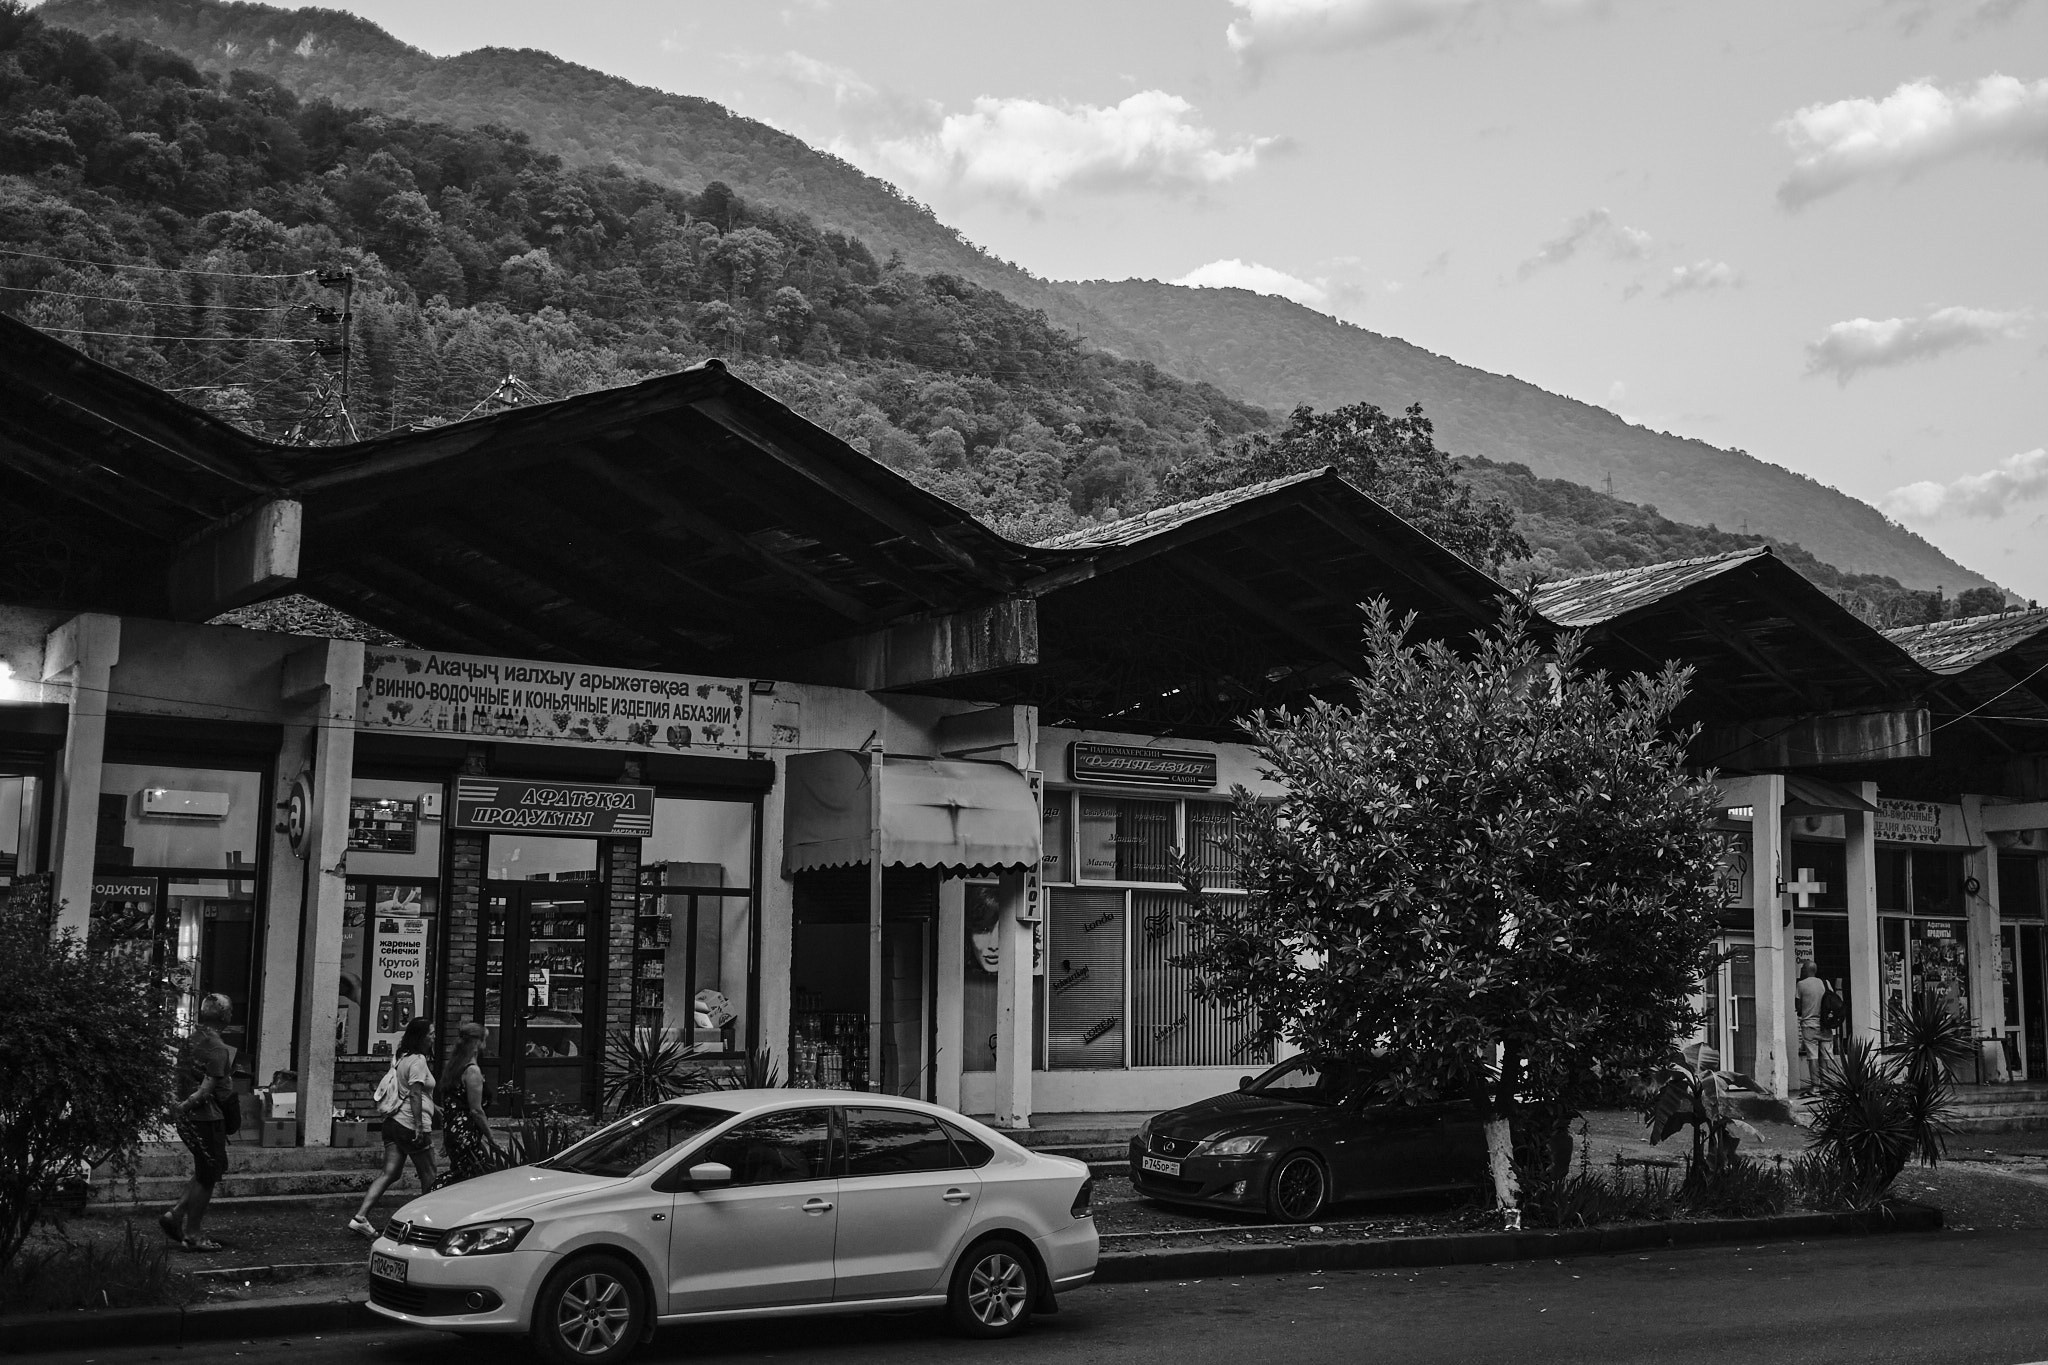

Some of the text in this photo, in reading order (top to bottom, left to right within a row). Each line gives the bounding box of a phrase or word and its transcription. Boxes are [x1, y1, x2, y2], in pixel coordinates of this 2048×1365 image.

[504, 666, 575, 690] иалхыу
[376, 678, 730, 724] ВИННО-ВОДОЧНЫЕ И КОНЬЯЧНЫЕ ИЗДЕЛИЯ АБХАЗИИ
[1171, 775, 1196, 784] САЛОН
[471, 807, 595, 827] ПРОДУКТЫ
[1874, 809, 1933, 822] НО-ВОДОЧНЫЕ
[1874, 821, 1900, 832] ДЕЛИЯ
[91, 884, 151, 896] ОДУКТЫ
[1083, 912, 1114, 933] Londa
[1146, 921, 1175, 943] WELLA
[379, 940, 421, 949] жареные
[381, 946, 419, 955] семечки
[379, 957, 419, 969] Крутой
[384, 968, 414, 979] Окер
